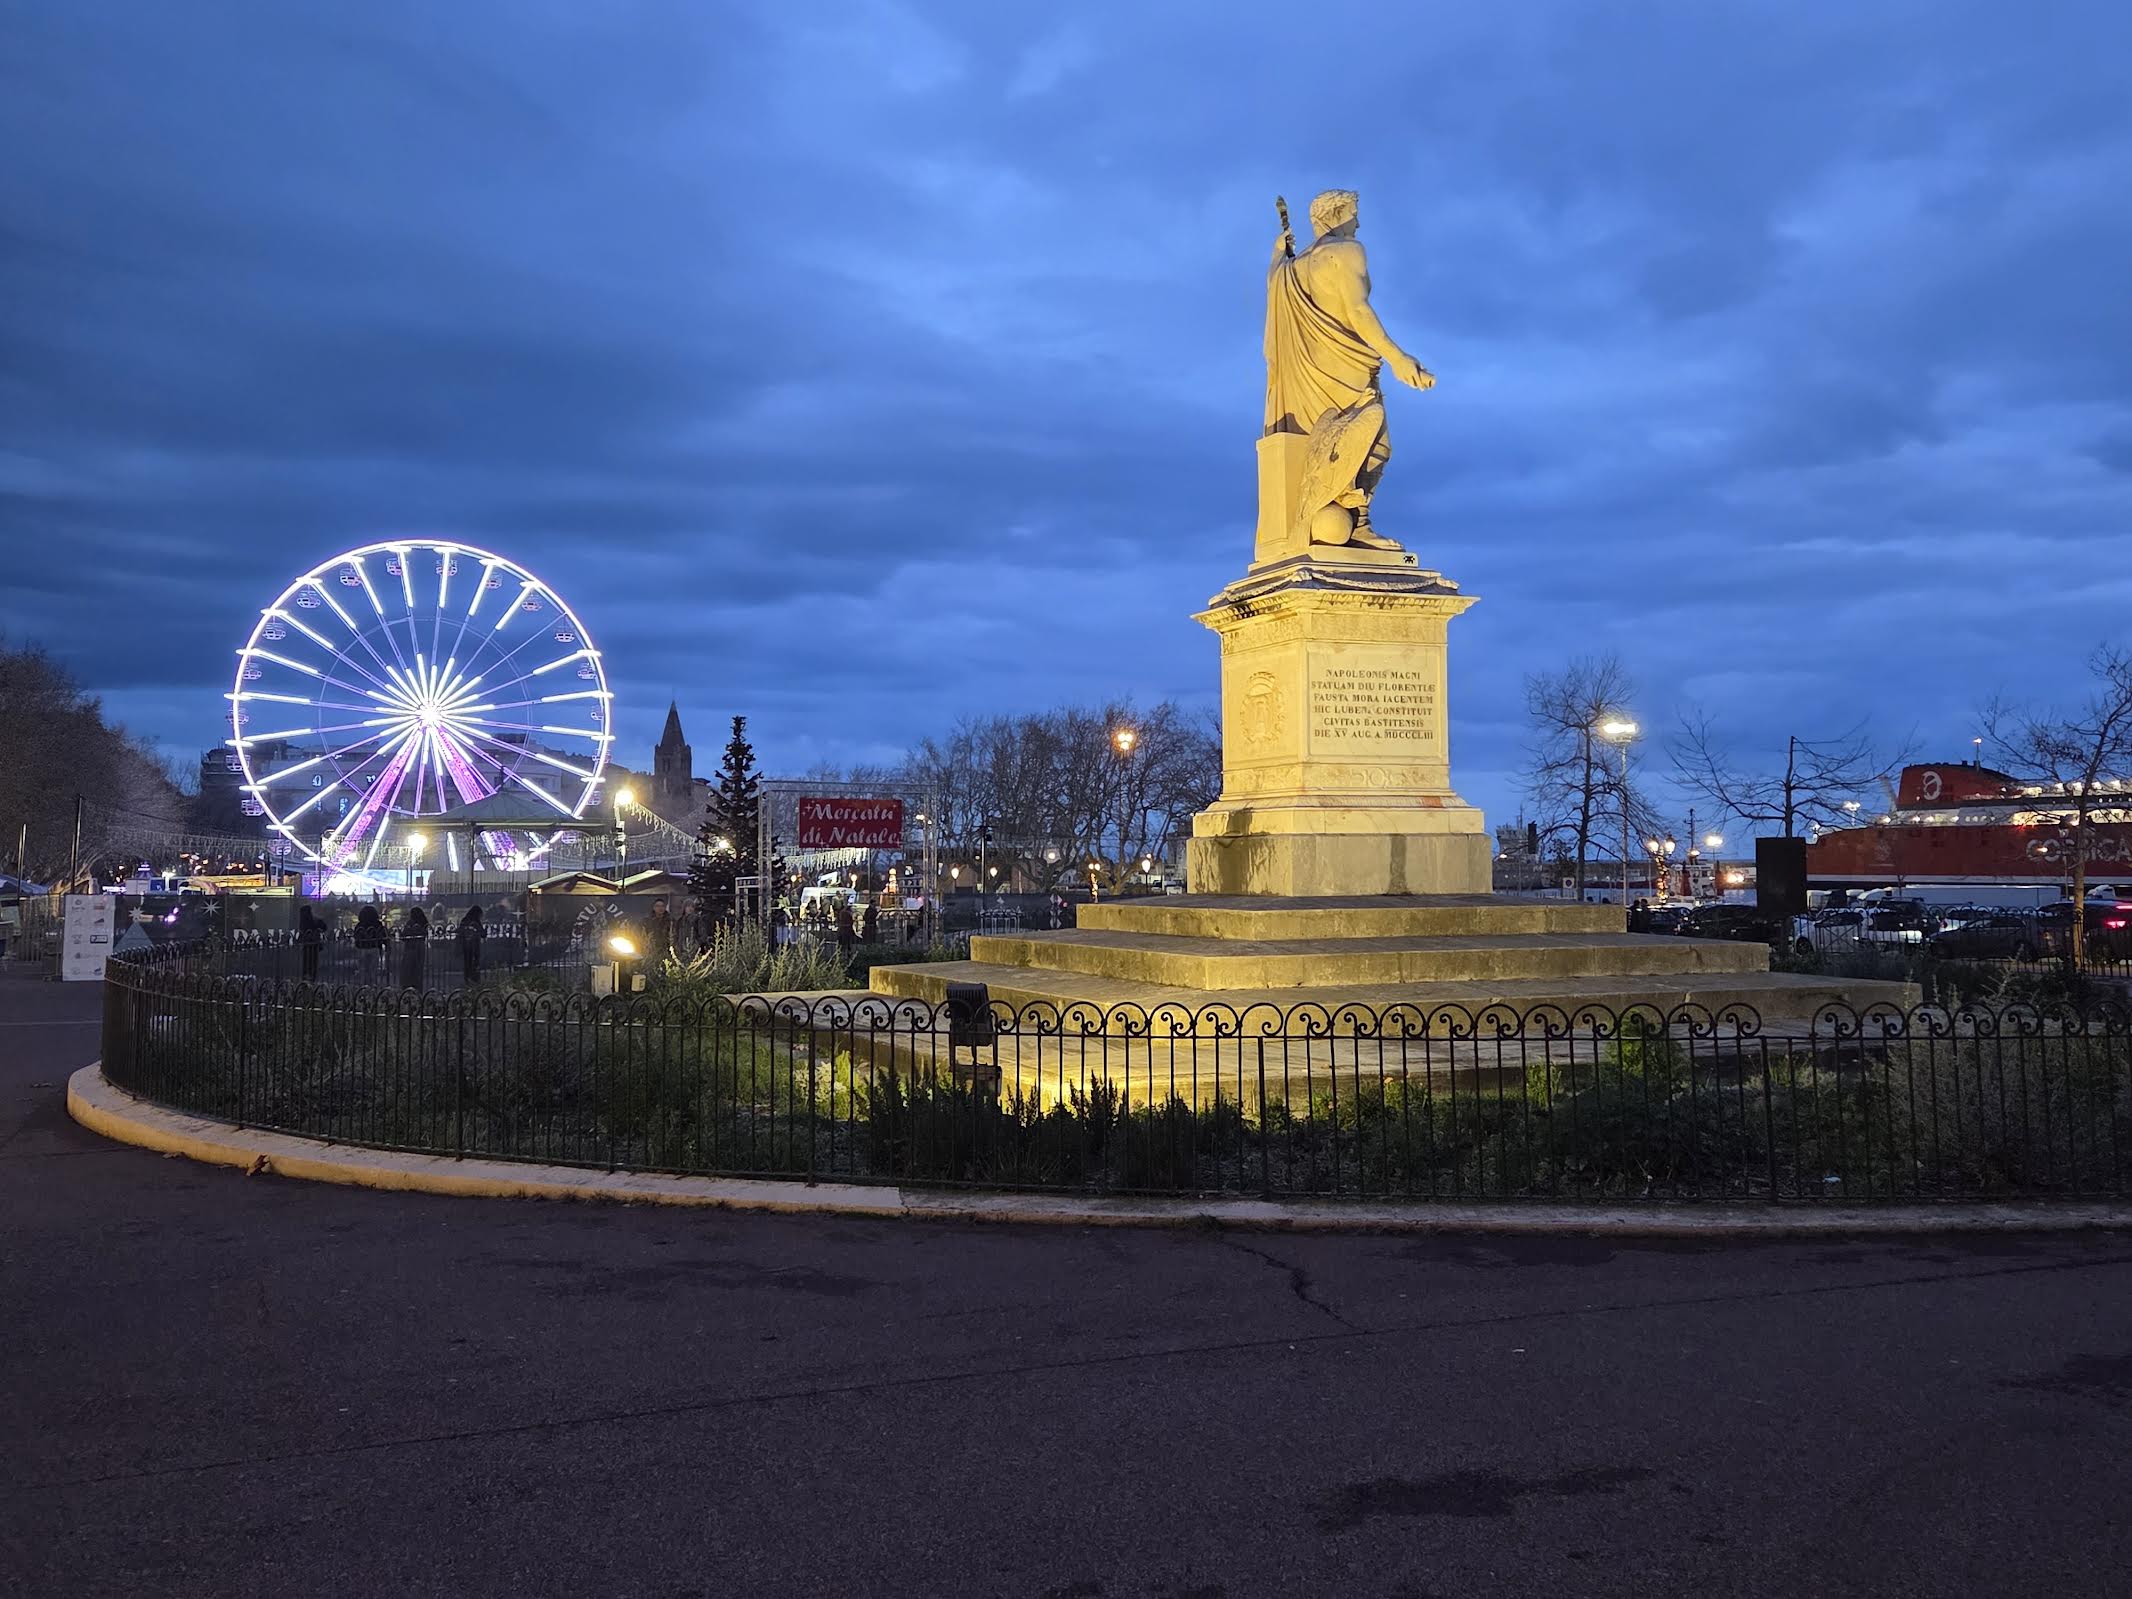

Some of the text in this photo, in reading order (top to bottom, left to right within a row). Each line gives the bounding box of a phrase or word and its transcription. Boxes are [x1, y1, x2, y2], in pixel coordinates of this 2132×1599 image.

[1326, 669, 1420, 680] NAPOLEONIS MAGNI
[1311, 681, 1355, 690] STATUAM
[1358, 682, 1375, 691] DIU
[1314, 693, 1433, 704] FAUSTA MORA IACENTEM
[1314, 705, 1331, 714] HIC
[1376, 707, 1432, 716] CONSTITUIT
[1323, 717, 1424, 727] CIVITAS BASTITENSIS
[1314, 729, 1330, 738] DIE
[1334, 728, 1347, 738] XV
[1385, 729, 1433, 739] MDCCCLIII
[809, 803, 894, 820] Mercatu
[802, 826, 897, 844] di Natale
